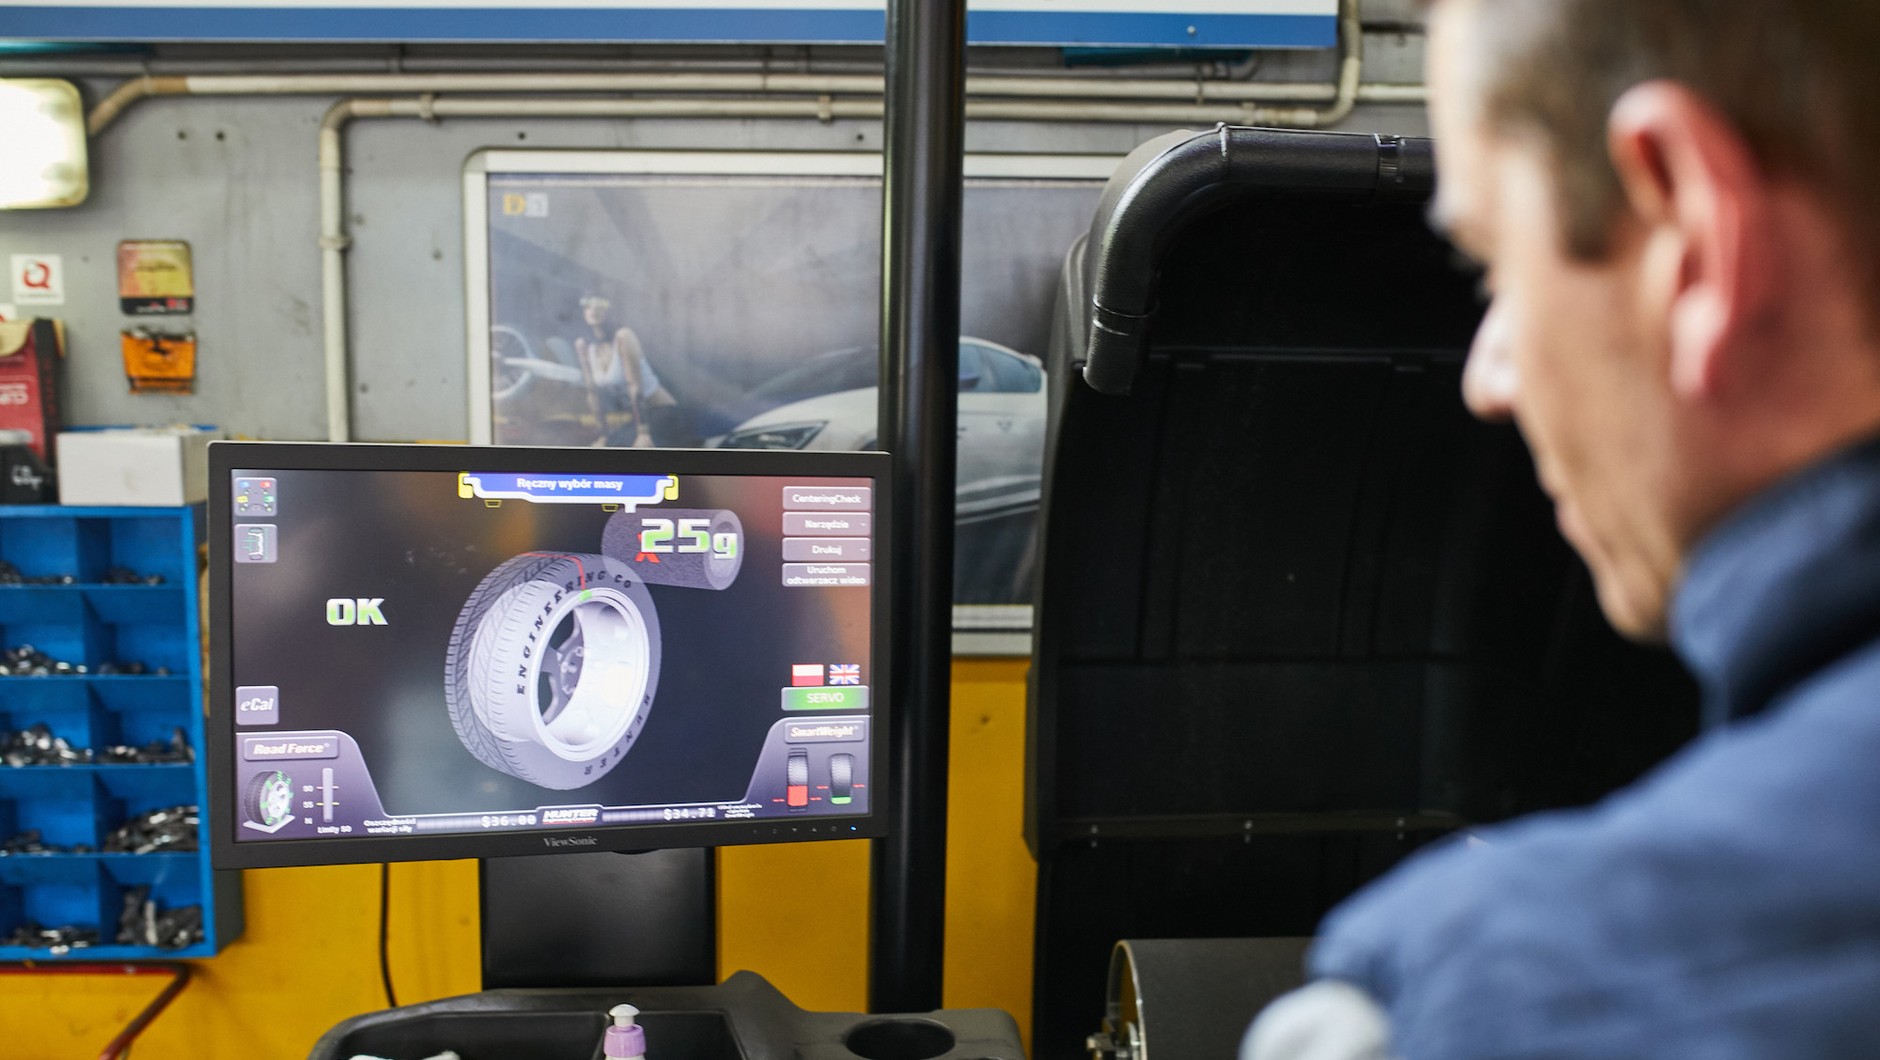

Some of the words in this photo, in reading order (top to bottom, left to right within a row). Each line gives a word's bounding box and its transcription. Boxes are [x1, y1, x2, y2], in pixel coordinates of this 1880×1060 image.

[517, 478, 556, 490] Ręczny
[558, 478, 591, 491] wybór
[594, 480, 623, 491] masy
[792, 494, 861, 504] CenteringCheck
[812, 545, 842, 555] Drukuj
[807, 566, 847, 574] Uruchom
[839, 576, 866, 584] wideo
[326, 598, 389, 626] OK
[517, 570, 606, 696] ENGINEERING
[613, 573, 632, 588] CO
[806, 692, 844, 704] SERVO
[240, 698, 274, 711] eCal
[253, 744, 287, 755] Road
[543, 809, 599, 820] HUNTER
[481, 815, 537, 828] $36.00
[543, 836, 598, 847] ViewSonic
